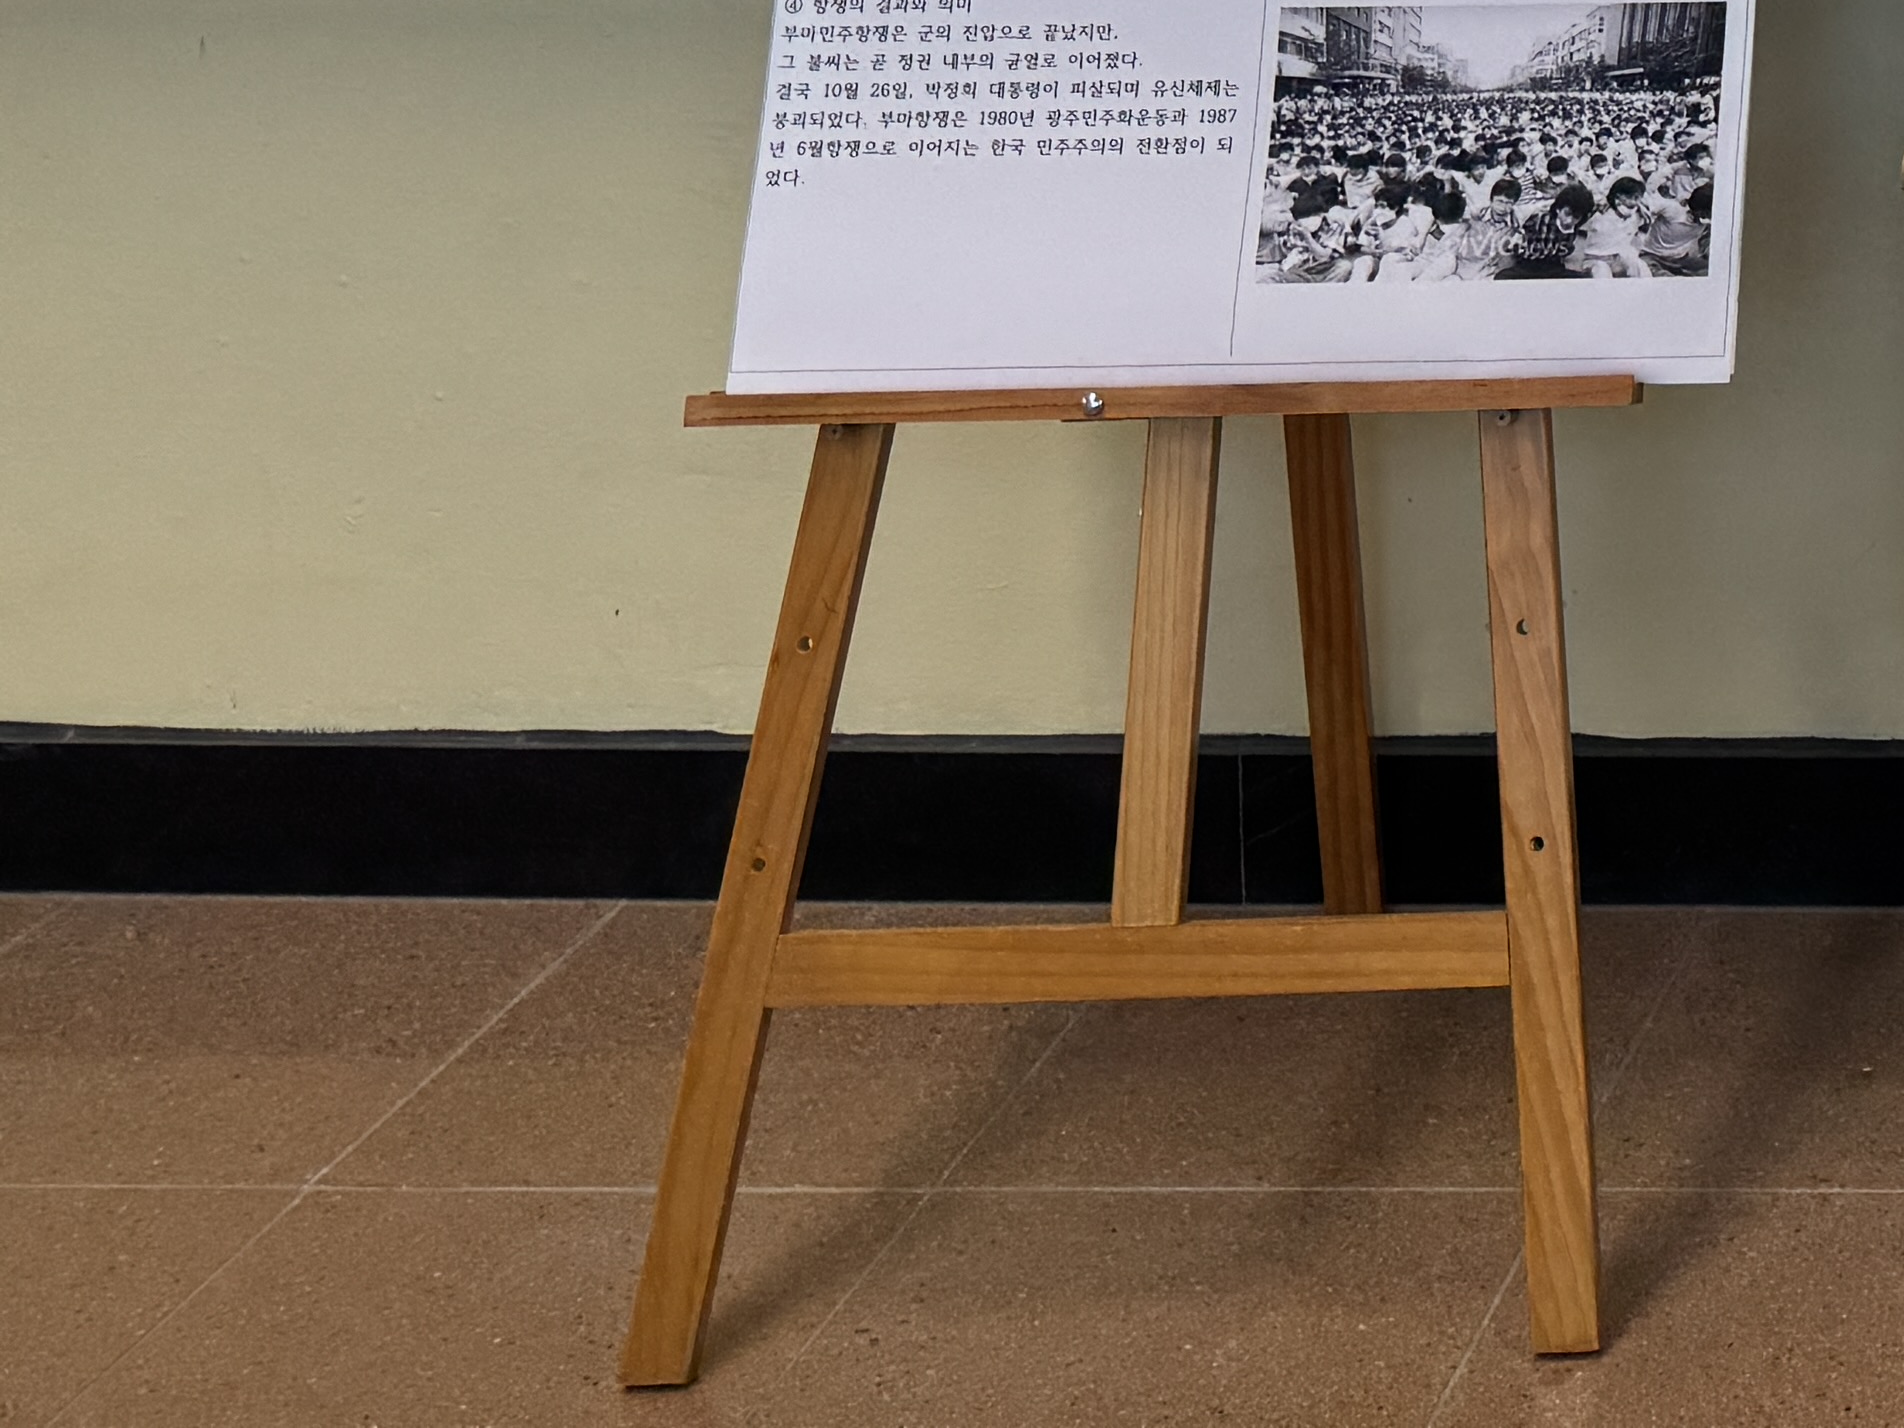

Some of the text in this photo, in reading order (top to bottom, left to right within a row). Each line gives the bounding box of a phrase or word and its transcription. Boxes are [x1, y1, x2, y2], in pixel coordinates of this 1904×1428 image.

[917, 23, 952, 43] 군의
[1068, 50, 1143, 71] 이어졌다.
[823, 78, 1240, 101] 10월 유신체제는
[876, 107, 1238, 130] 부마항쟁은 1980년 광주민주화운동과 1987
[908, 138, 980, 159] 이어지는
[990, 138, 1027, 157] 한국
[1036, 136, 1124, 157] 민주주의의
[1216, 135, 1233, 155] 되
[765, 168, 805, 188] 었다.
